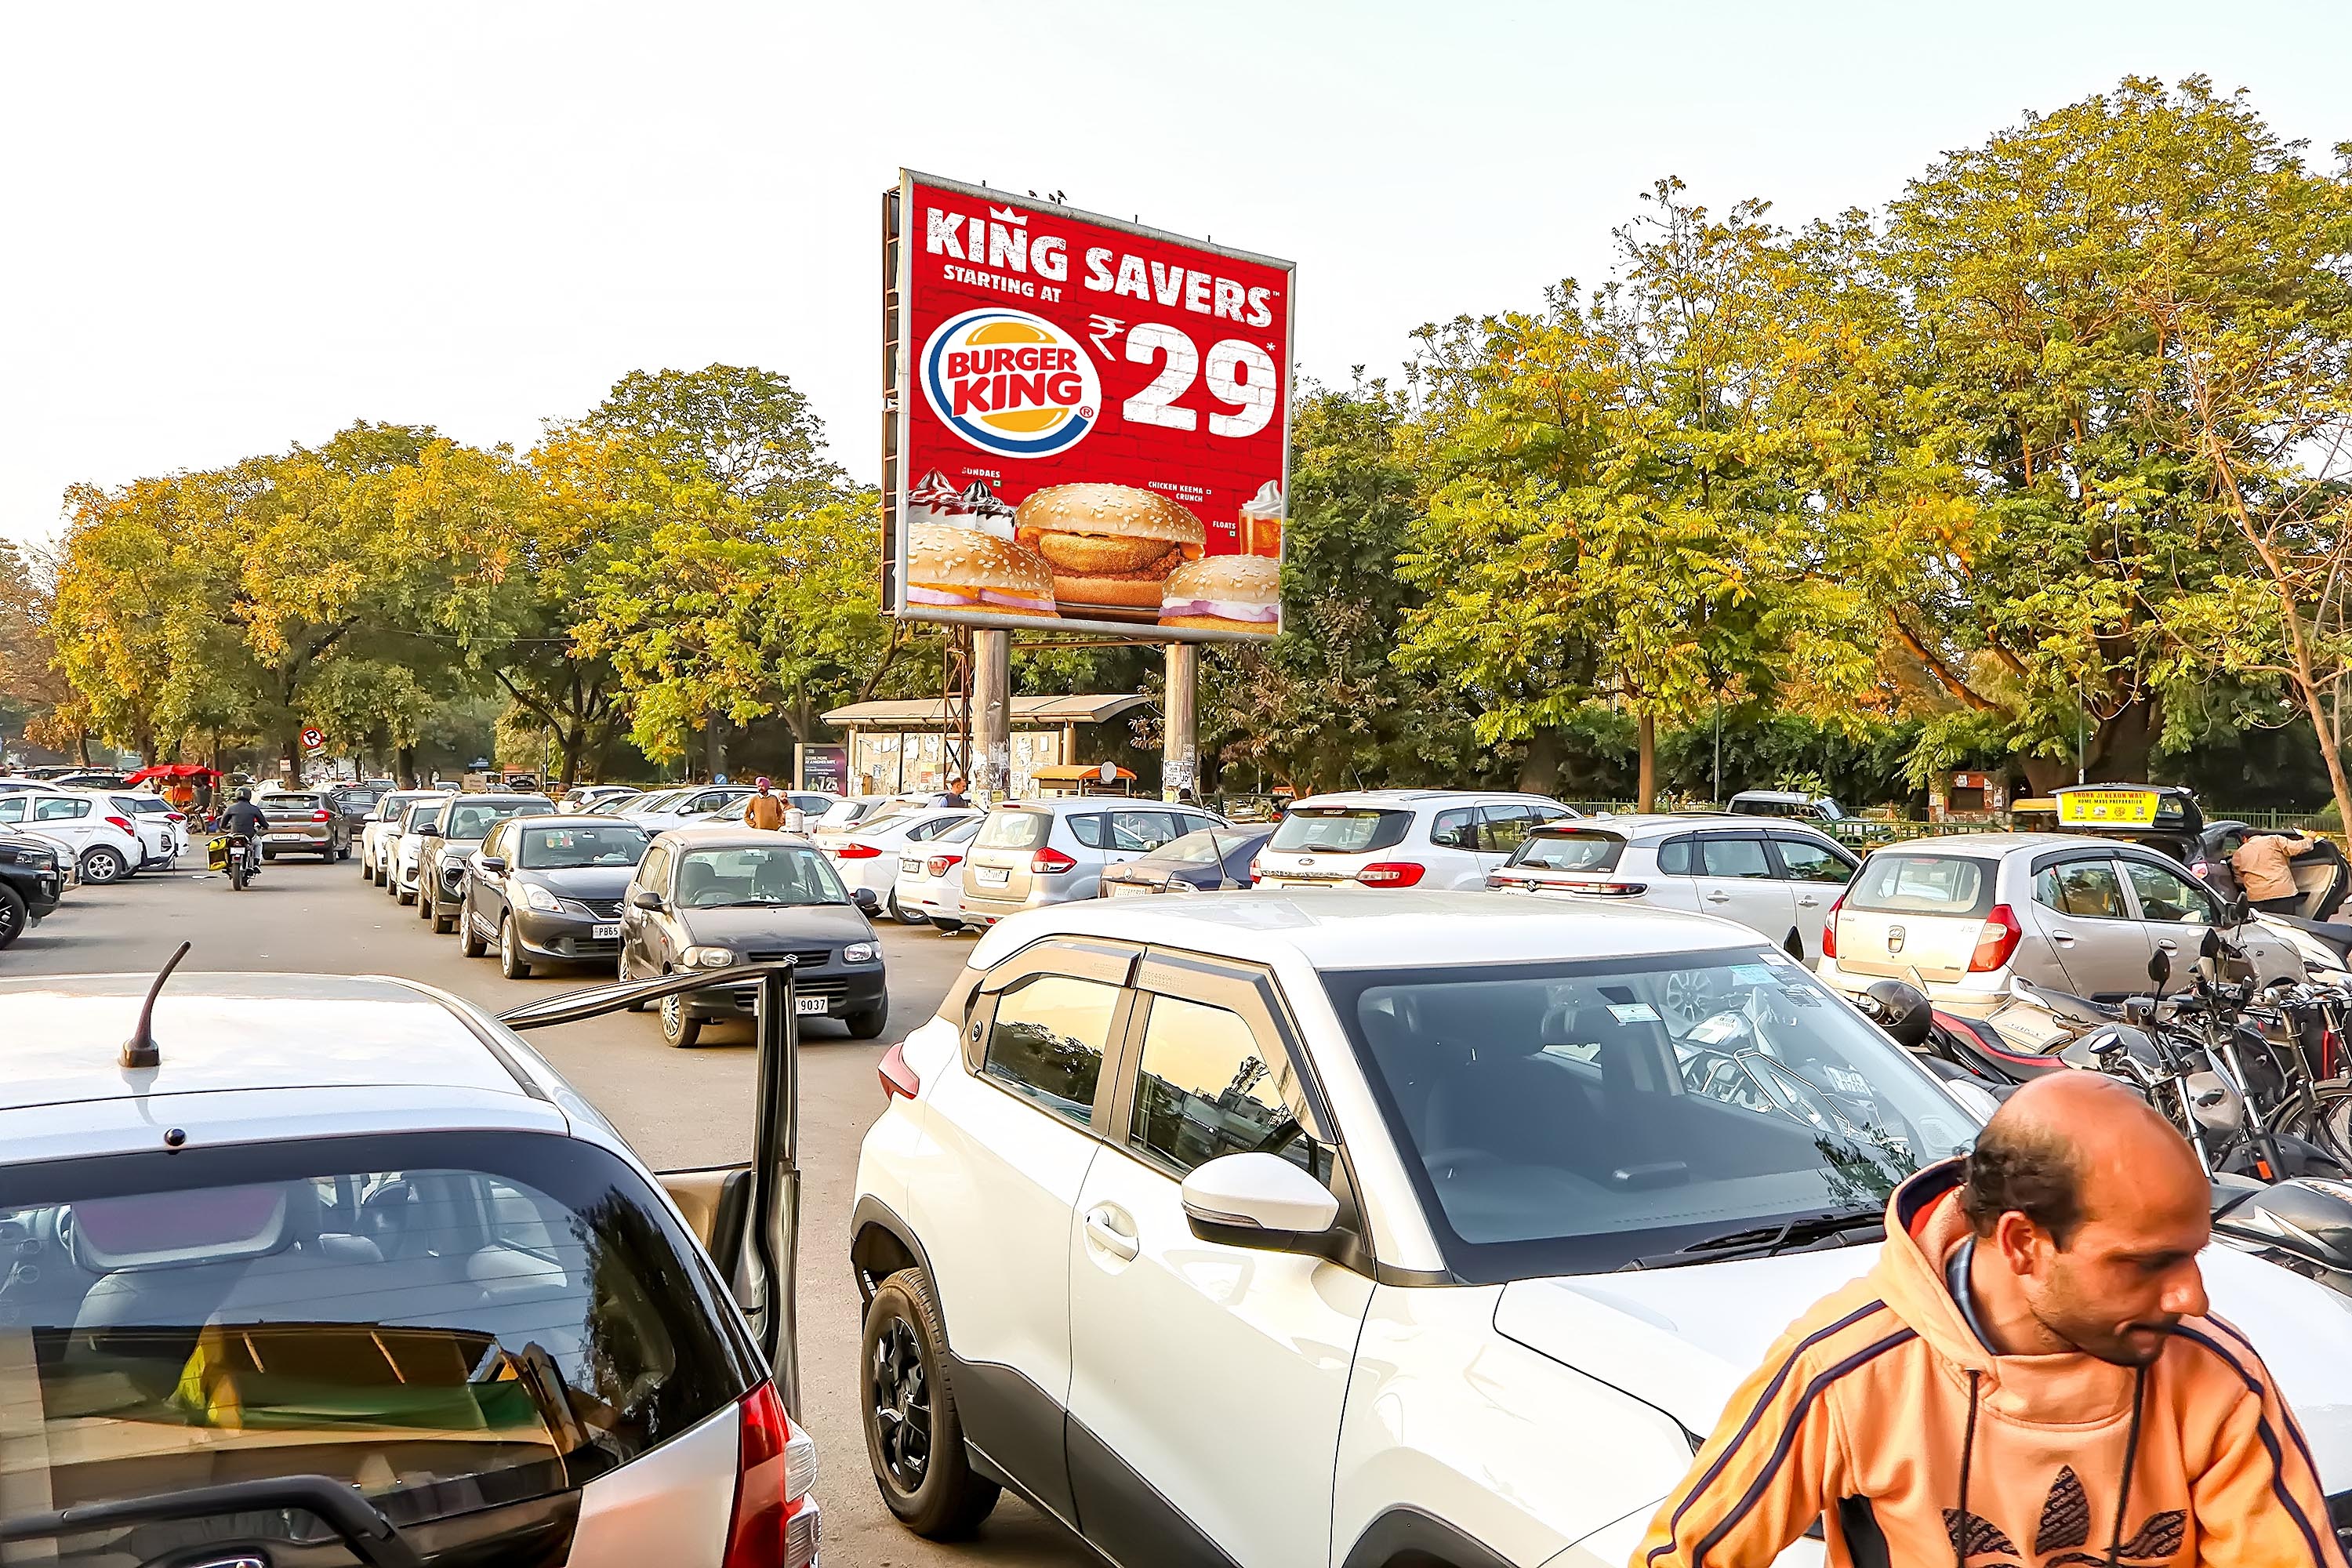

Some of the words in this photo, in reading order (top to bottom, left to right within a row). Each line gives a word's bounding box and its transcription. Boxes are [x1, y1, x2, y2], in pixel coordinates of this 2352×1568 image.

[927, 207, 1068, 282] KING
[943, 264, 1034, 298] STARTING
[1040, 285, 1062, 303] AT
[947, 347, 1077, 379] BURGER
[953, 372, 1083, 416] KING
[1148, 481, 1178, 492] CHICKEN
[1179, 485, 1203, 495] KEEMA
[1175, 492, 1203, 503] CRUNCH
[1212, 520, 1236, 530] FLOATS
[599, 927, 619, 936] PB65
[800, 999, 826, 1011] 9037
